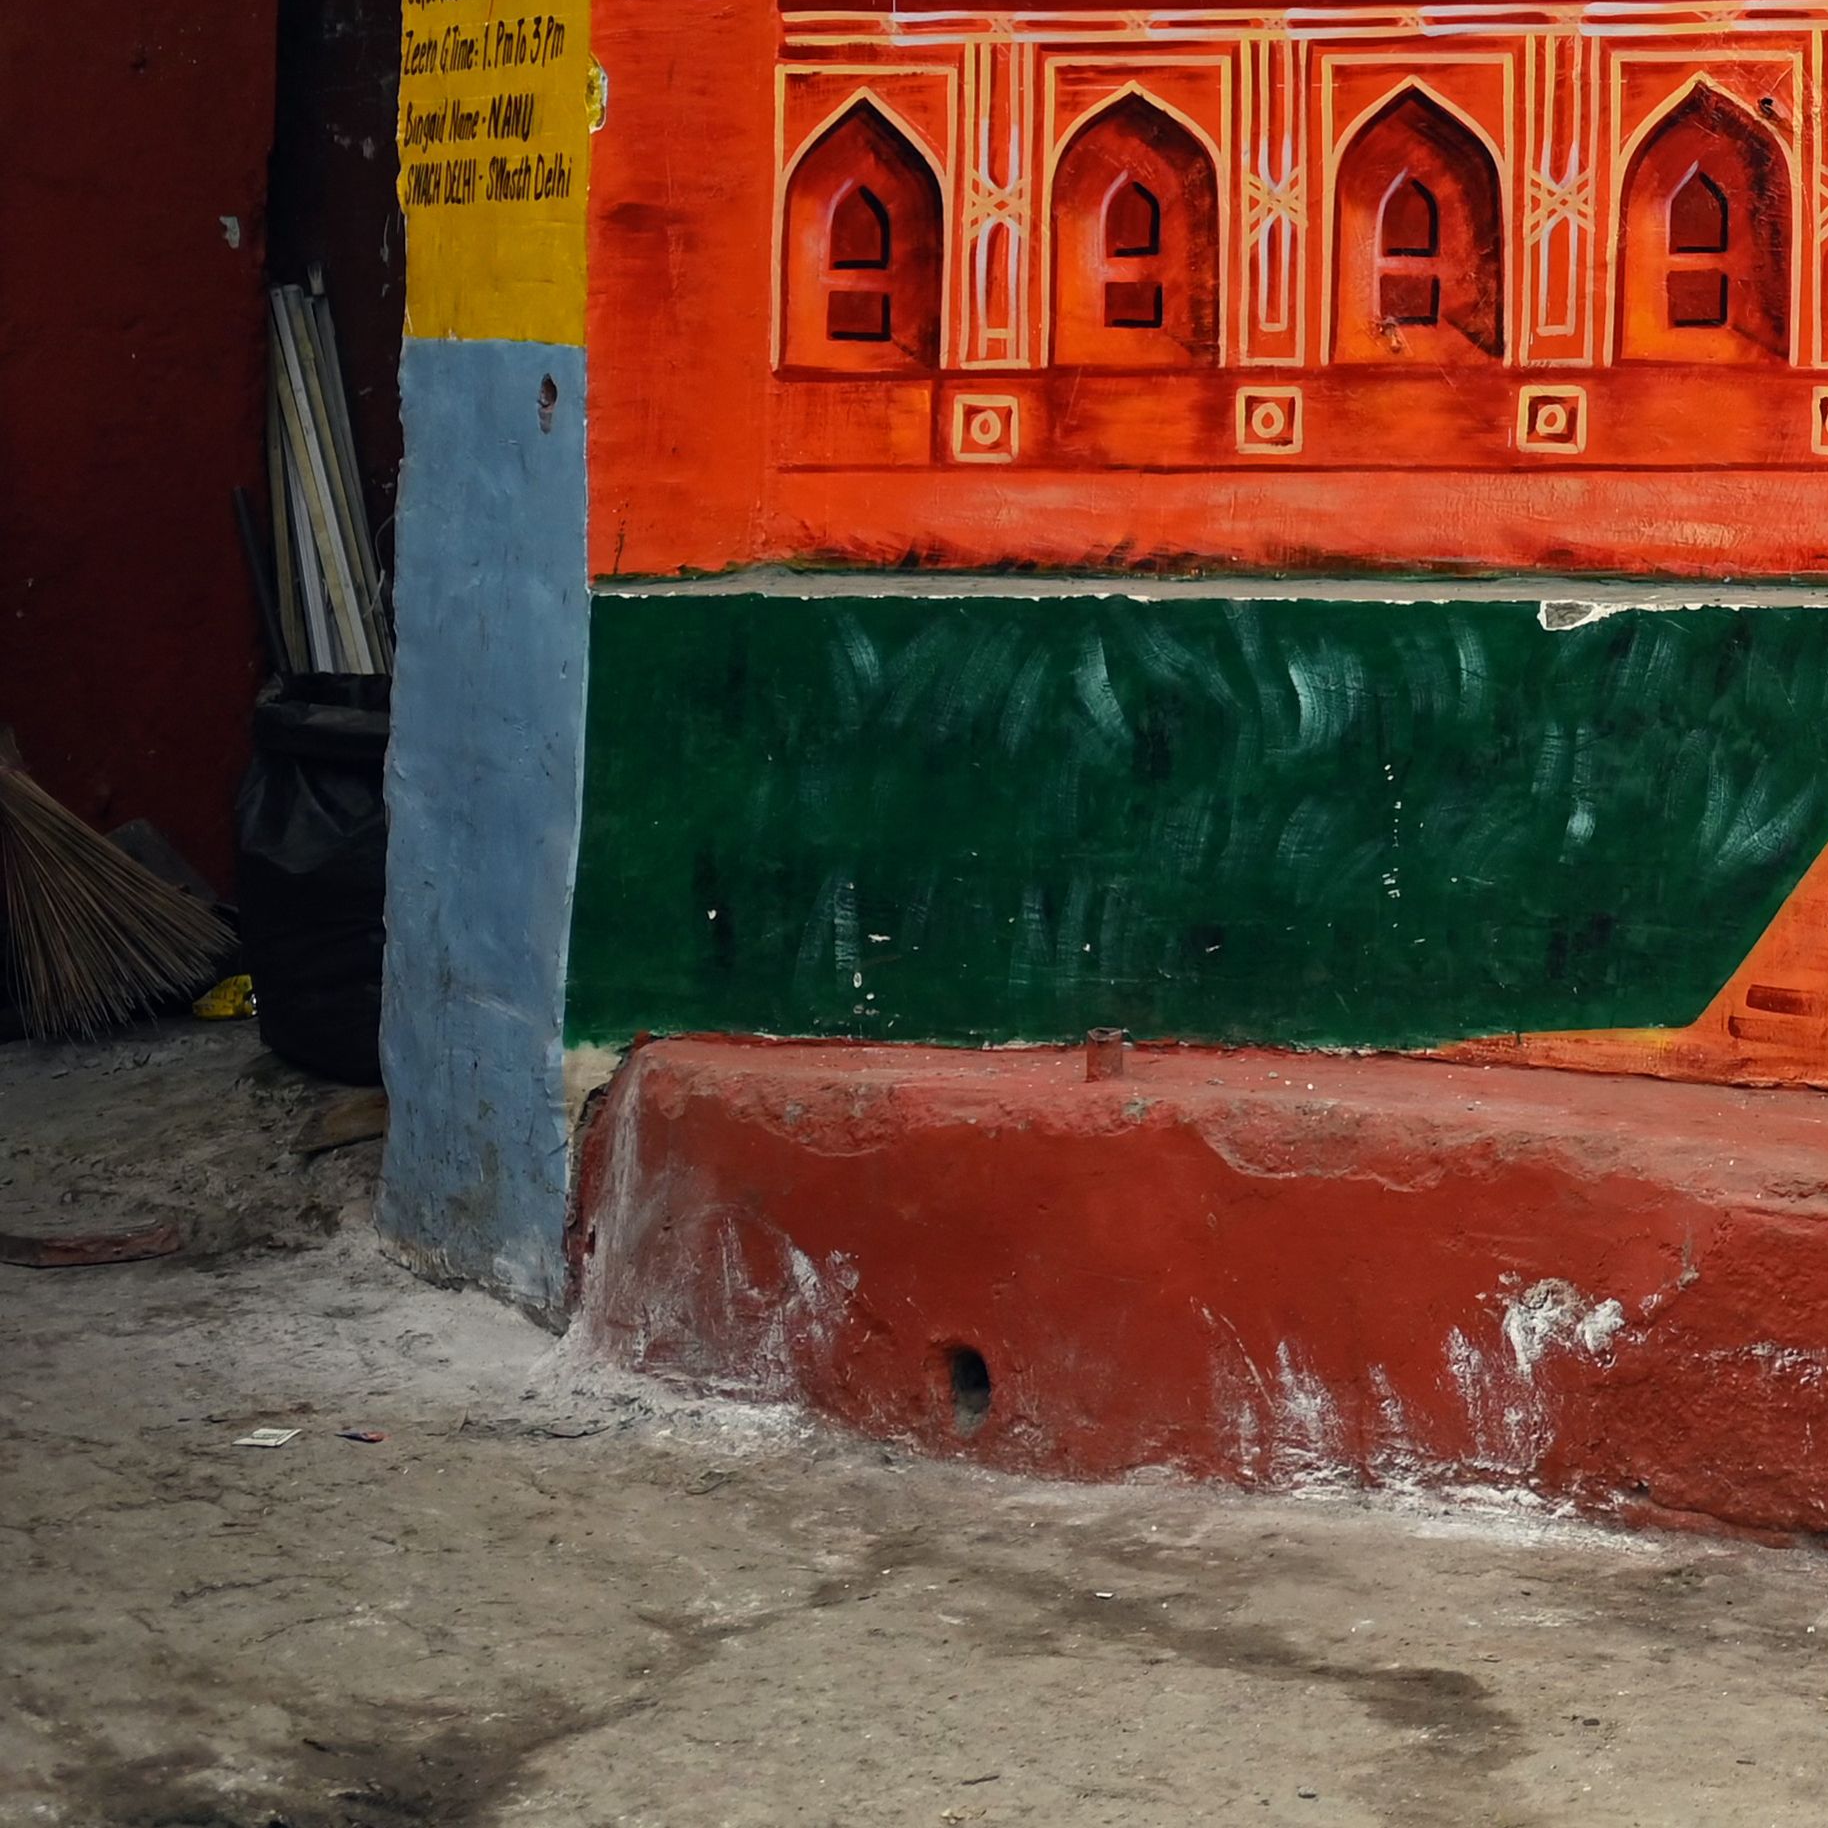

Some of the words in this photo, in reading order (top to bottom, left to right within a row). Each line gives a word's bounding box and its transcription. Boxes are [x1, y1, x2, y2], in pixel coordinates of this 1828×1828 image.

[487, 93, 534, 142] NANU
[444, 158, 477, 205] DELHI
[534, 151, 573, 201] Delhi
